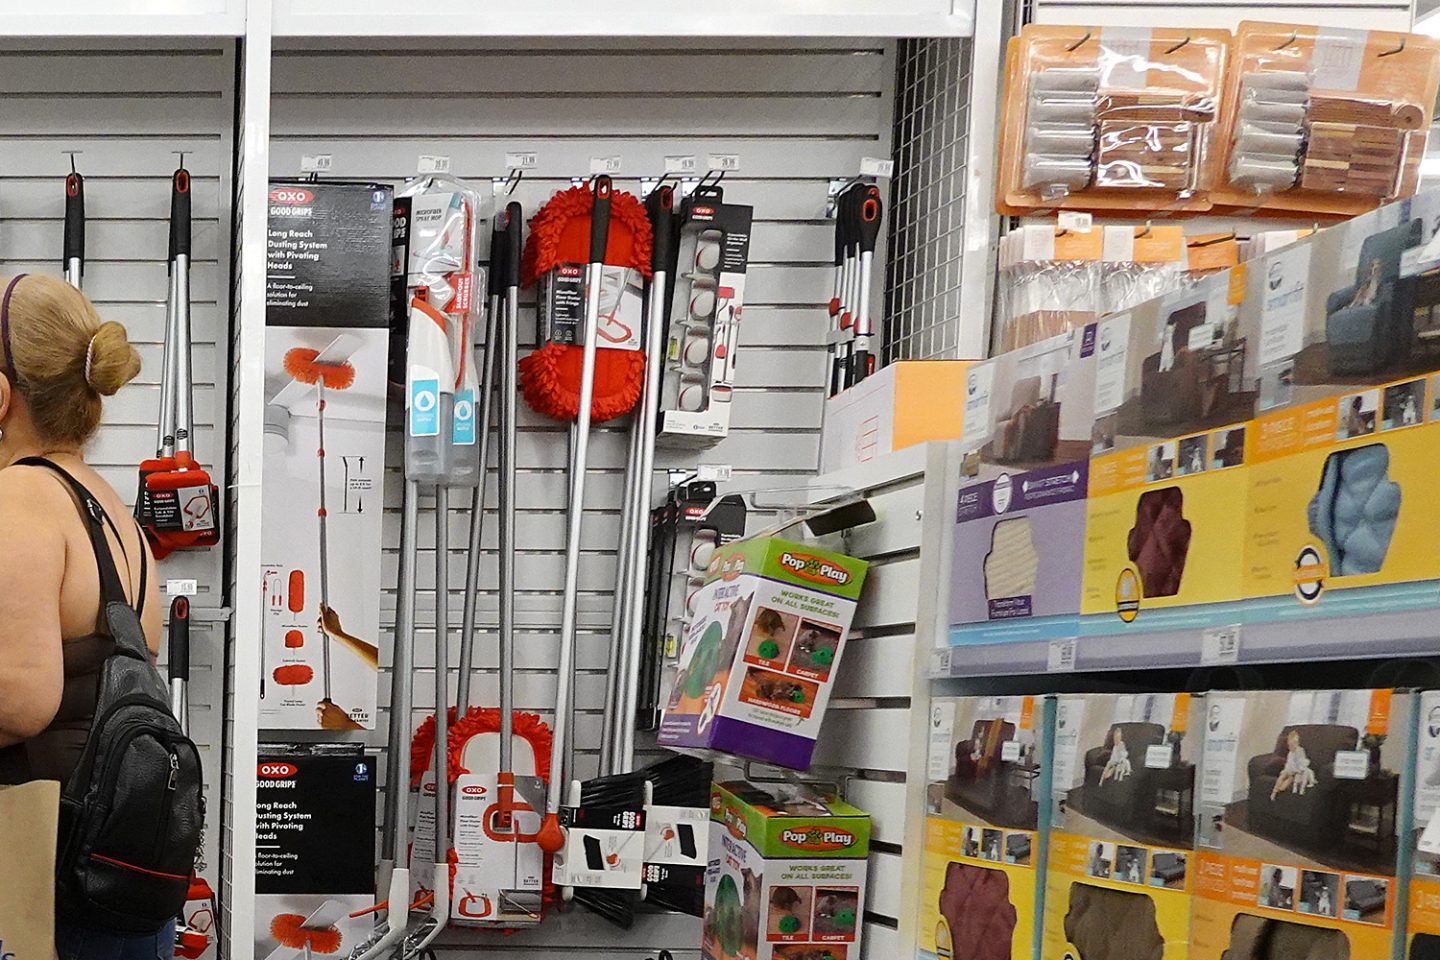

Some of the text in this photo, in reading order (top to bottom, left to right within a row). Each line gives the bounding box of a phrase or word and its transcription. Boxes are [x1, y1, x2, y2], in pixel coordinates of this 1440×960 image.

[277, 191, 307, 202] OXO
[270, 206, 313, 216] GOOD GRIPS
[268, 229, 313, 239] Long Reach
[268, 240, 328, 250] Dusting System
[268, 252, 320, 262] with Pivoting
[267, 262, 293, 271] Heads
[272, 283, 313, 292] floor-to-ceiling
[266, 300, 296, 308] eliminating
[781, 551, 848, 583] Pop Play
[771, 596, 784, 605] ON
[785, 600, 799, 609] ALL
[780, 588, 835, 608] WORKS GREAT
[758, 659, 770, 667] TILE
[795, 668, 820, 680] CARPET
[779, 704, 801, 715] FLOORS
[261, 765, 289, 775] OXO
[275, 780, 296, 789] GRIPS
[256, 801, 297, 811] ong Reach
[256, 812, 312, 821] usting System
[271, 822, 304, 832] Pivoting
[783, 831, 852, 846] Pop Play
[258, 852, 298, 861] floor-to-ceiling
[789, 864, 846, 873] WORKS GREAT
